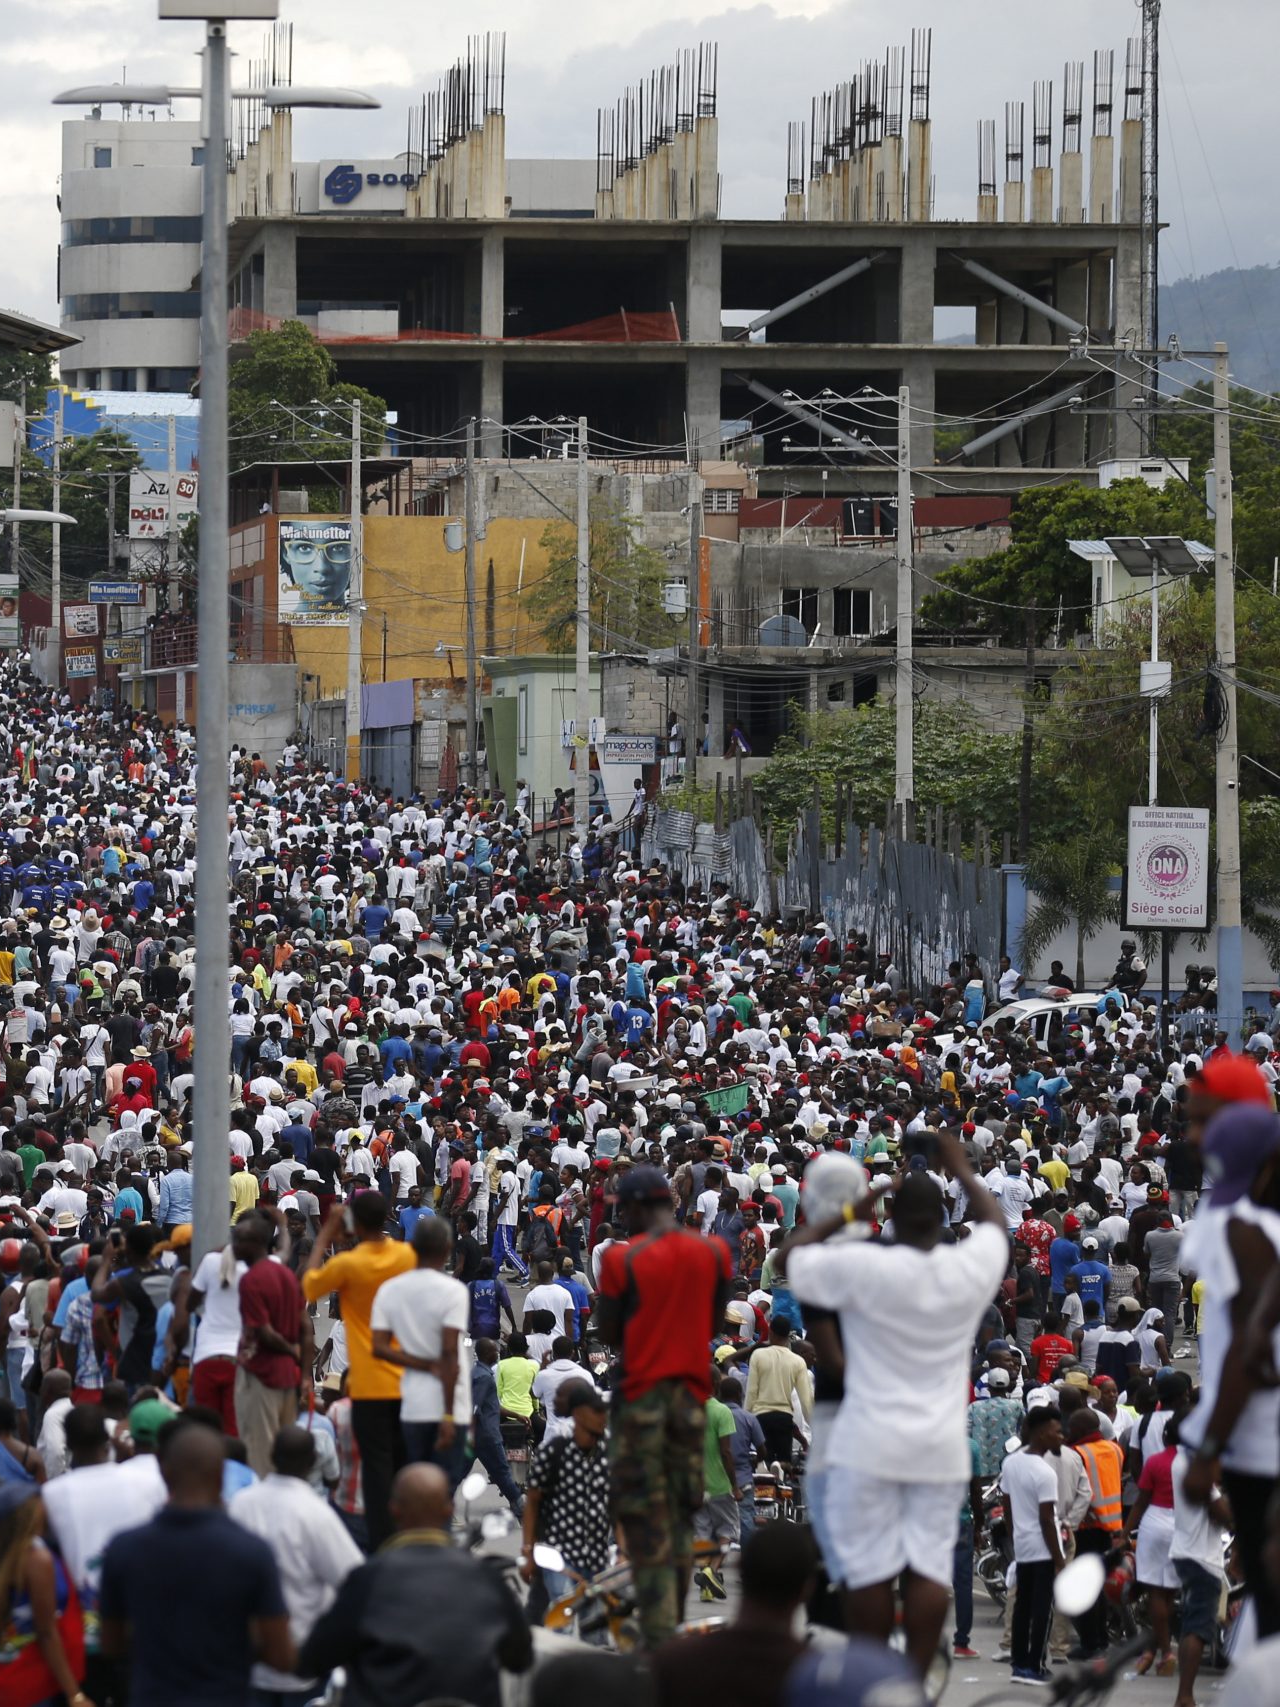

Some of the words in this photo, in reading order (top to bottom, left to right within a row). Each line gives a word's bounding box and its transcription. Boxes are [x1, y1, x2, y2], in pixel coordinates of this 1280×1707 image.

[180, 482, 193, 494] 30
[301, 526, 351, 539] Lunetter
[1145, 811, 1165, 819] OFFICE
[1132, 821, 1206, 829] D'ASSURANCE-VIEILLESSE
[1152, 858, 1183, 875] ONA
[1131, 902, 1164, 916] Siège
[1168, 903, 1203, 915] social
[631, 1015, 643, 1029] 13
